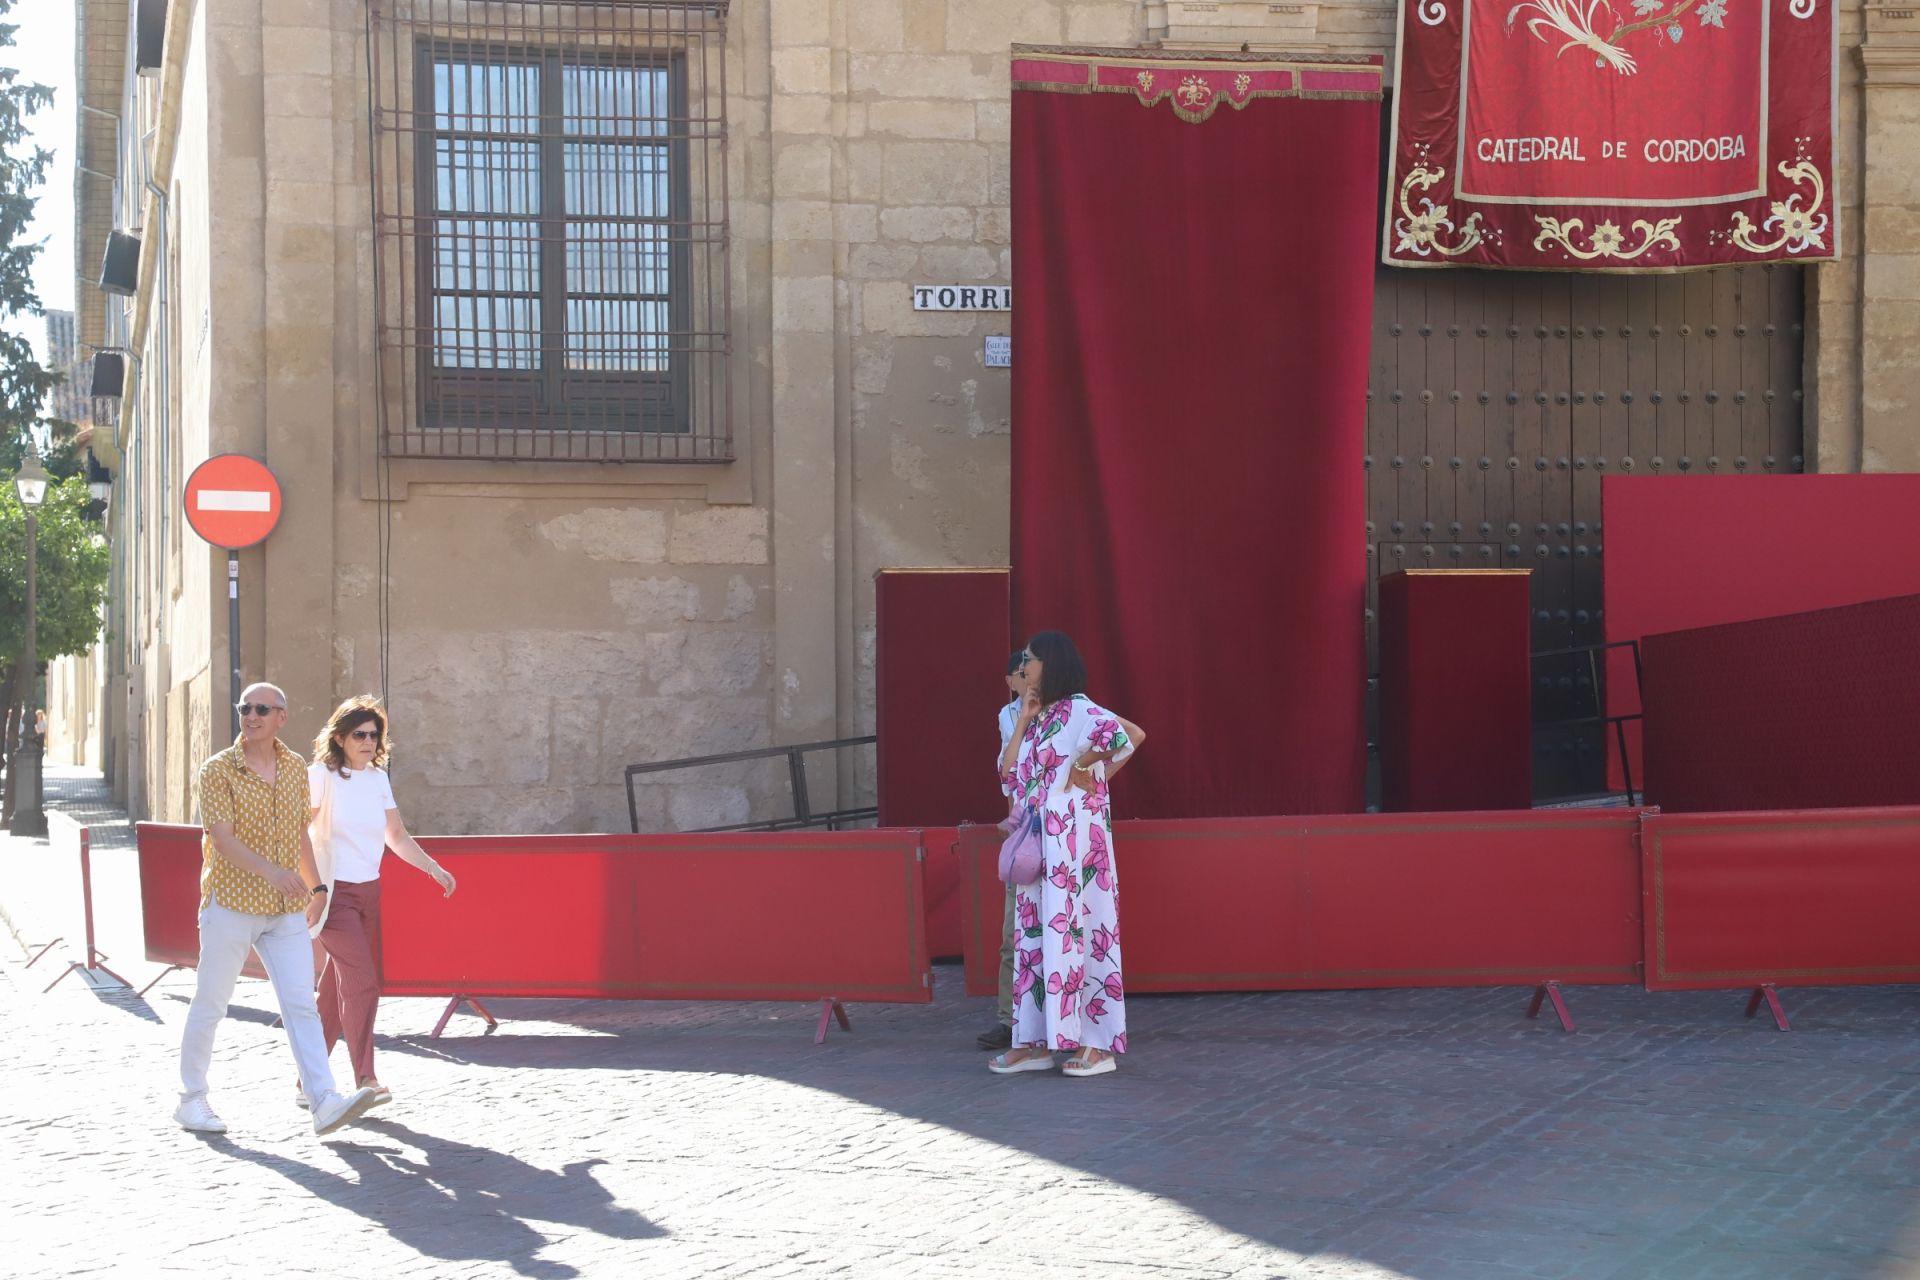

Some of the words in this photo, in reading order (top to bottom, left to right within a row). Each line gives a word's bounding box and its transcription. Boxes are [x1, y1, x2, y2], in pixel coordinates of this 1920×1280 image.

[1477, 136, 1586, 163] CATEDRAL
[1602, 140, 1628, 159] DE
[1643, 134, 1746, 163] CORDOBA
[915, 287, 1011, 309] TORRI
